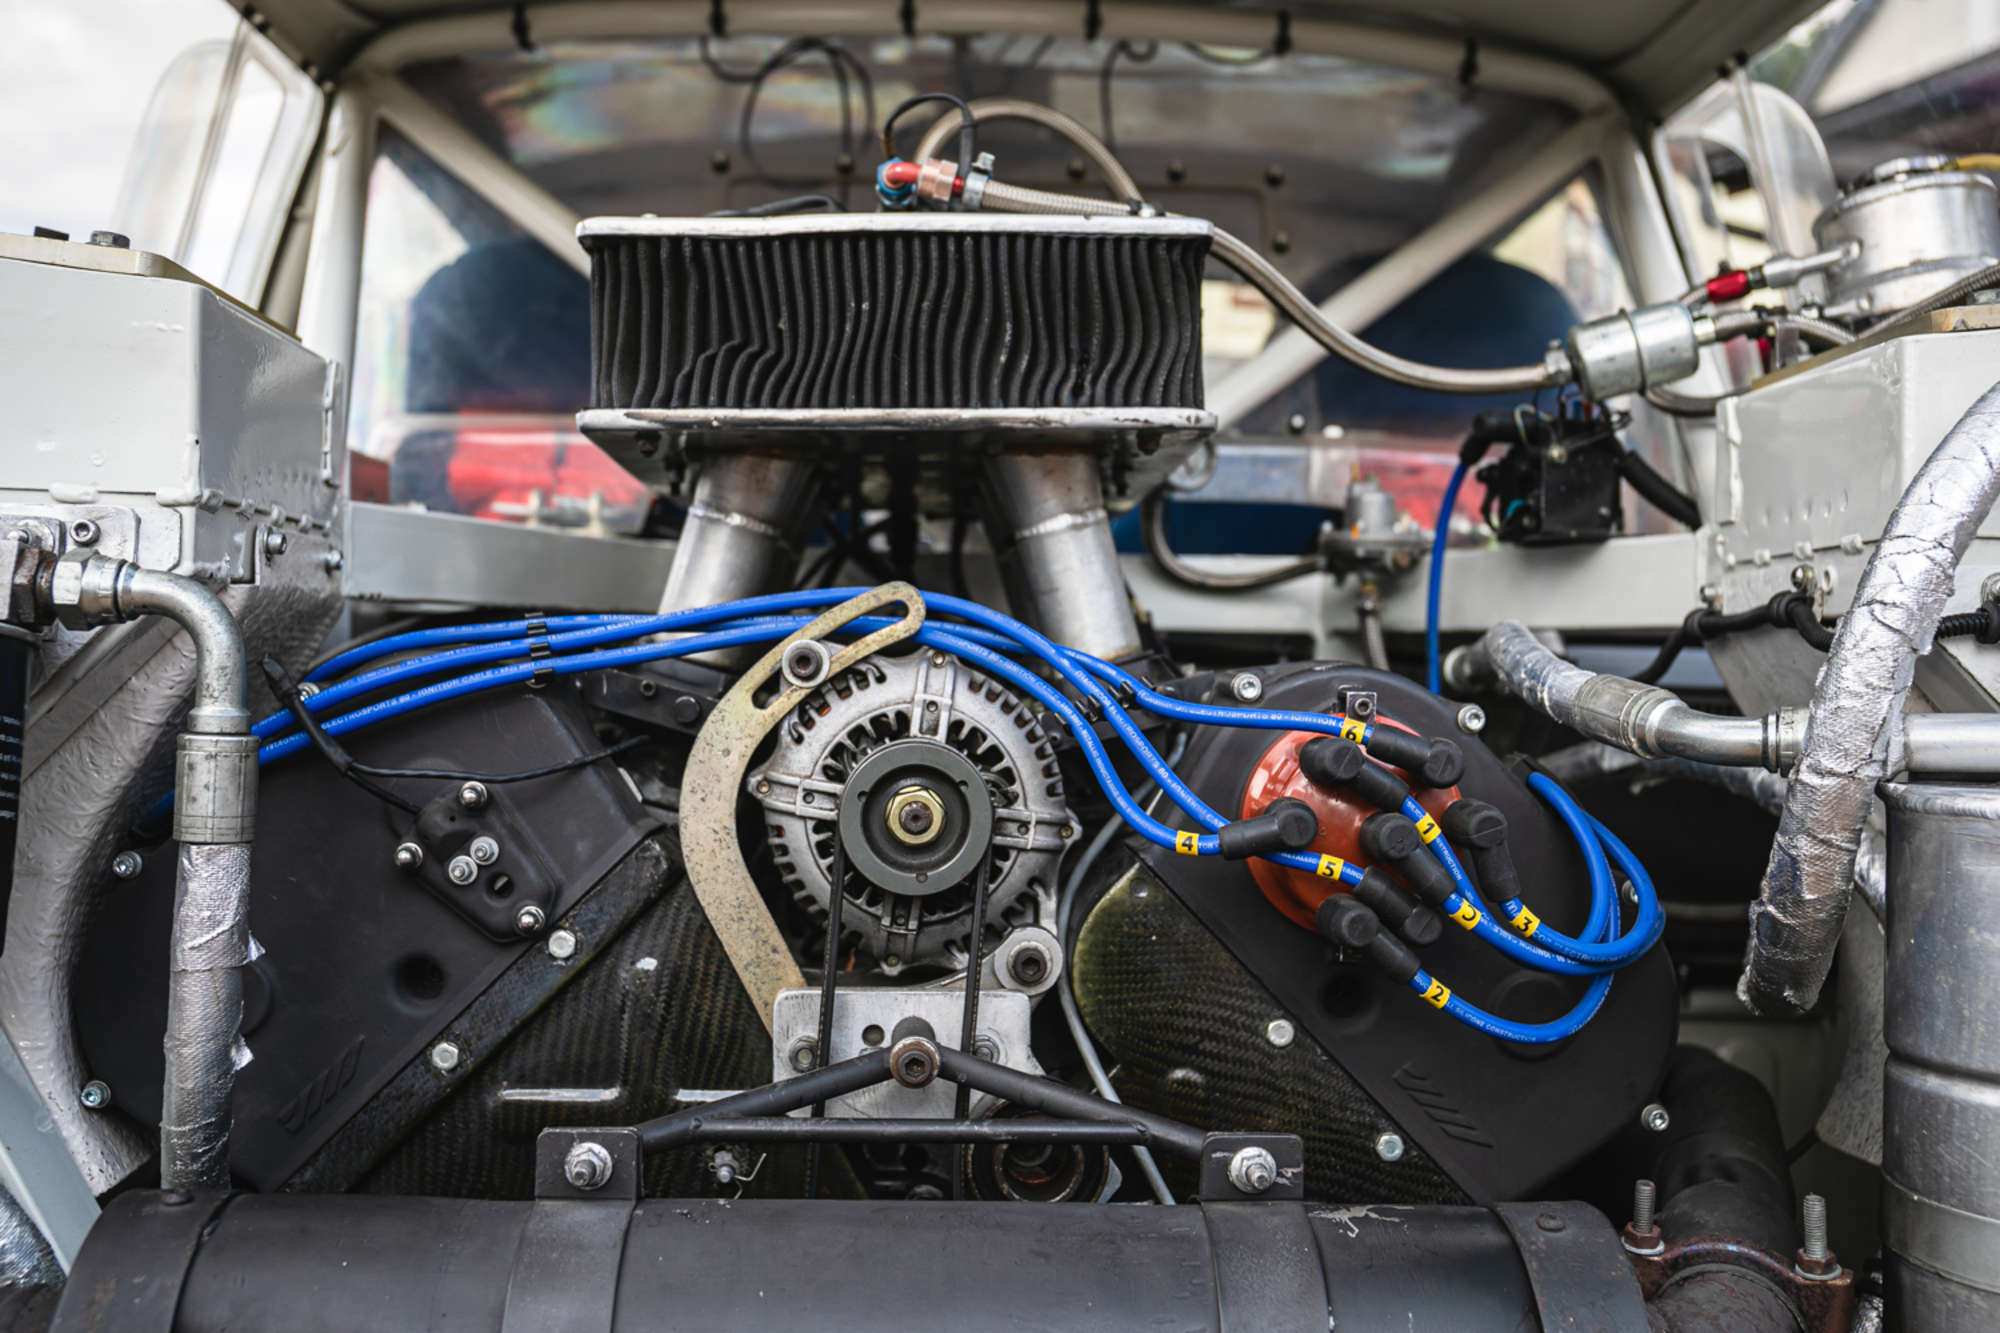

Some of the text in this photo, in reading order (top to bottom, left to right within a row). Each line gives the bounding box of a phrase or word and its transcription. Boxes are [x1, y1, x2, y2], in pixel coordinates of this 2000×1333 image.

[1345, 725, 1357, 741] 6
[1422, 822, 1435, 835] 1
[1181, 835, 1194, 852] 4
[1321, 860, 1337, 877] 5
[1516, 916, 1533, 932] 3
[1431, 985, 1445, 1002] 2
